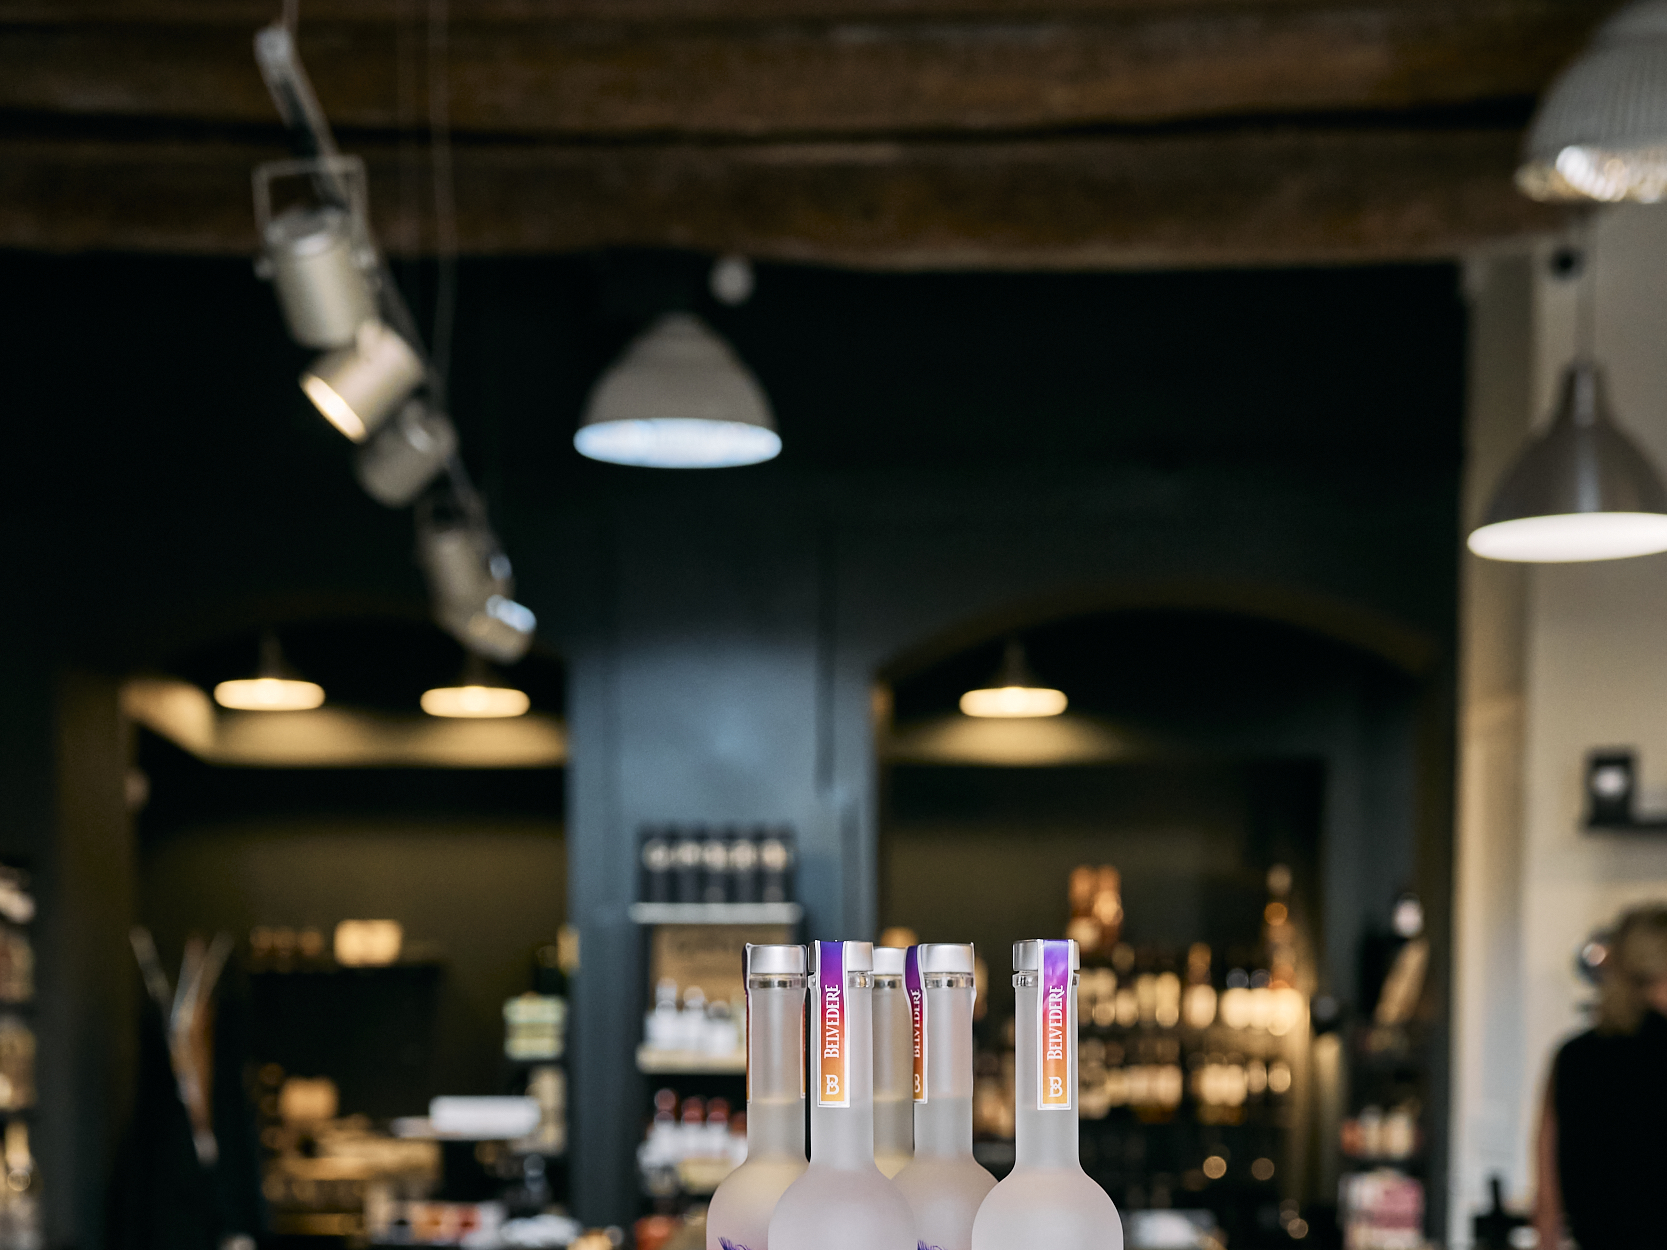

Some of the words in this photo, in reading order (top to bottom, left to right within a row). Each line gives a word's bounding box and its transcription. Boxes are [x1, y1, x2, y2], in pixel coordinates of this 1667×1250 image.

[824, 984, 841, 1059] BELVEDERE
[910, 988, 922, 1058] BELVEDERE
[1047, 985, 1065, 1060] BELVEDERE
